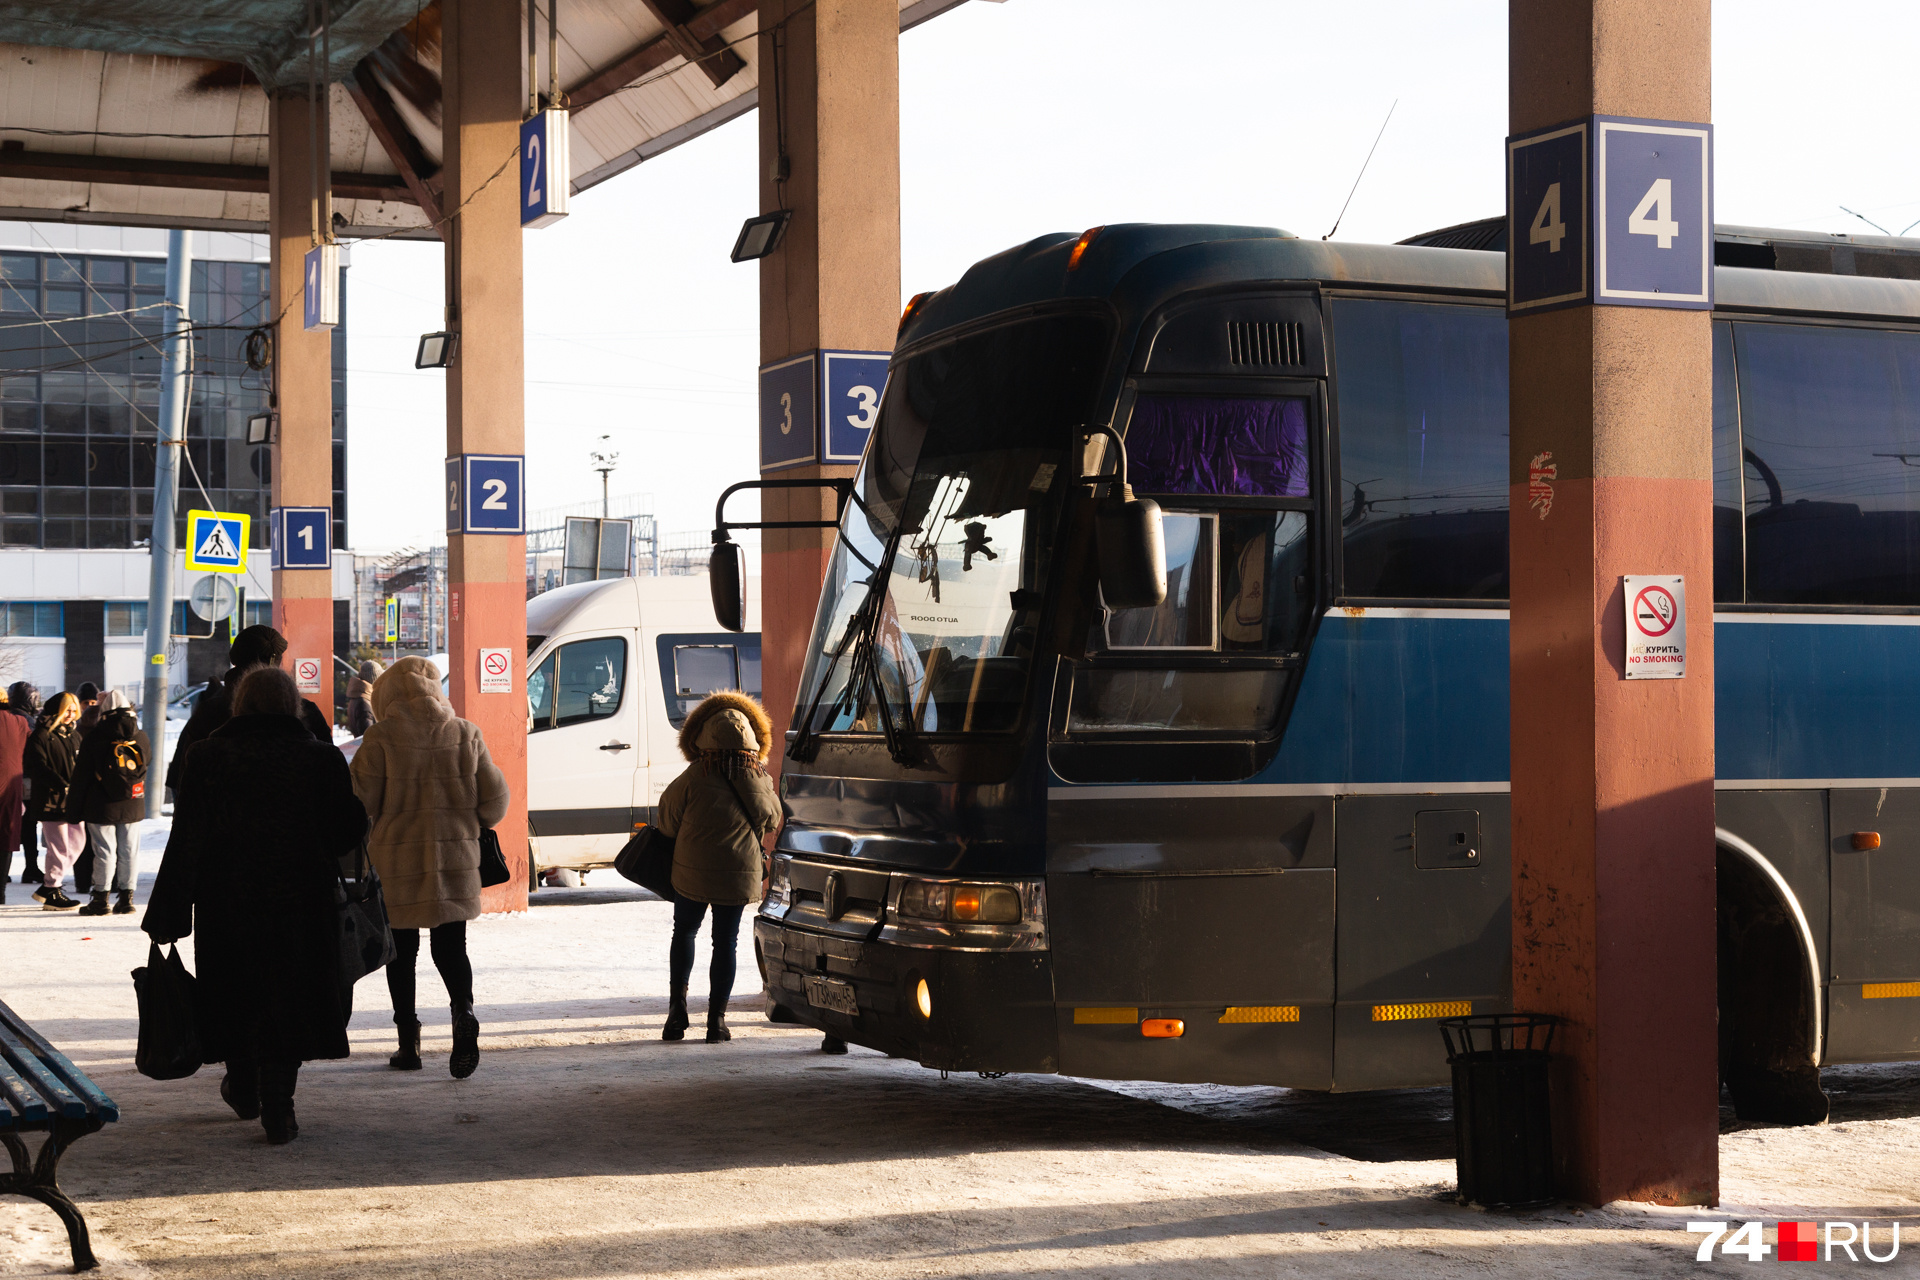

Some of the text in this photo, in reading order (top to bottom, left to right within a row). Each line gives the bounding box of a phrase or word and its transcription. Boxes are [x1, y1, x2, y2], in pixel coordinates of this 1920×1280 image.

[528, 133, 541, 208] 2
[1529, 181, 1566, 253] 4
[1628, 178, 1679, 249] 4
[309, 260, 317, 315] 1
[780, 392, 793, 435] 3
[846, 384, 878, 430] 3
[449, 480, 458, 512] 2
[481, 478, 508, 511] 2
[273, 526, 278, 552] 1
[297, 525, 313, 551] 1
[1643, 655, 1683, 663] SMOKING
